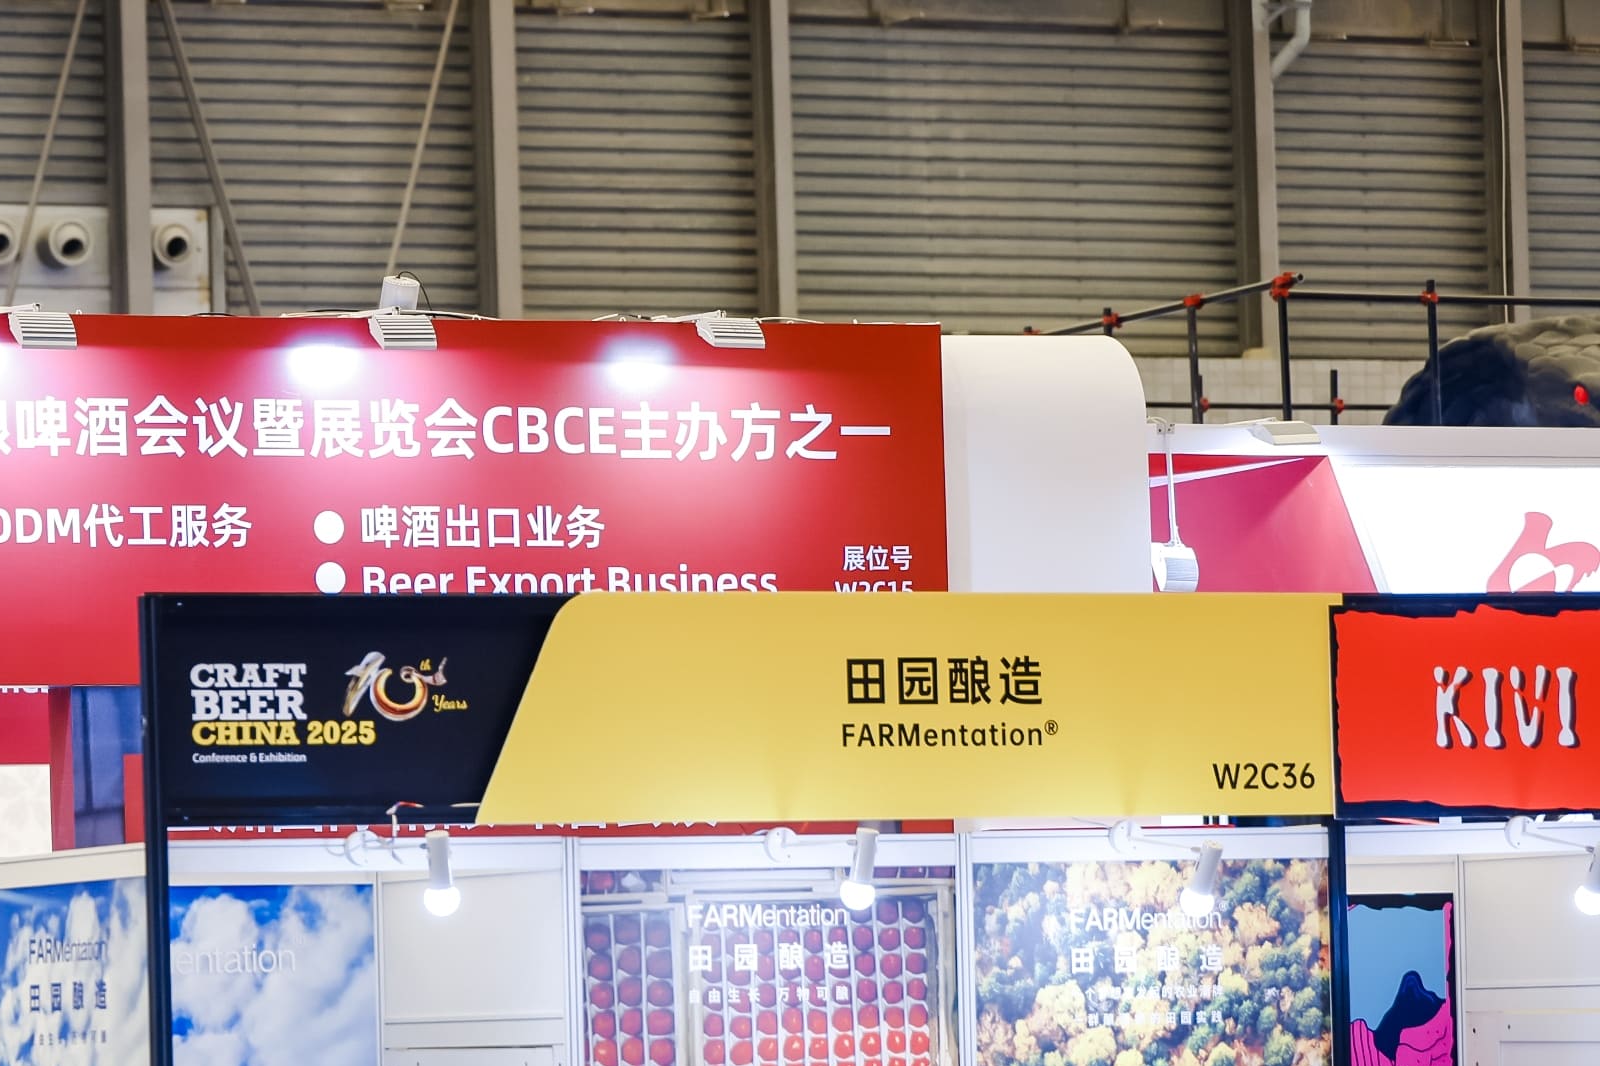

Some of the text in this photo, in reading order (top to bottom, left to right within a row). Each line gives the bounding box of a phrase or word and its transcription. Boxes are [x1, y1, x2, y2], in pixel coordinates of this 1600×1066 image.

[361, 504, 605, 550] 啤酒出口业务
[843, 545, 913, 571] 展位号
[362, 566, 453, 594] Beer
[190, 662, 307, 689] CRAFT
[847, 656, 1043, 705] 田园酿造
[191, 690, 307, 720] BEER
[431, 694, 468, 712] Years
[192, 720, 376, 745] CHINA 2025
[192, 752, 247, 763] Conference
[259, 751, 307, 763] Exhibition
[1212, 763, 1316, 790] W2C36
[688, 942, 849, 972] 田园酿造
[1070, 944, 1223, 974] 田园酿造
